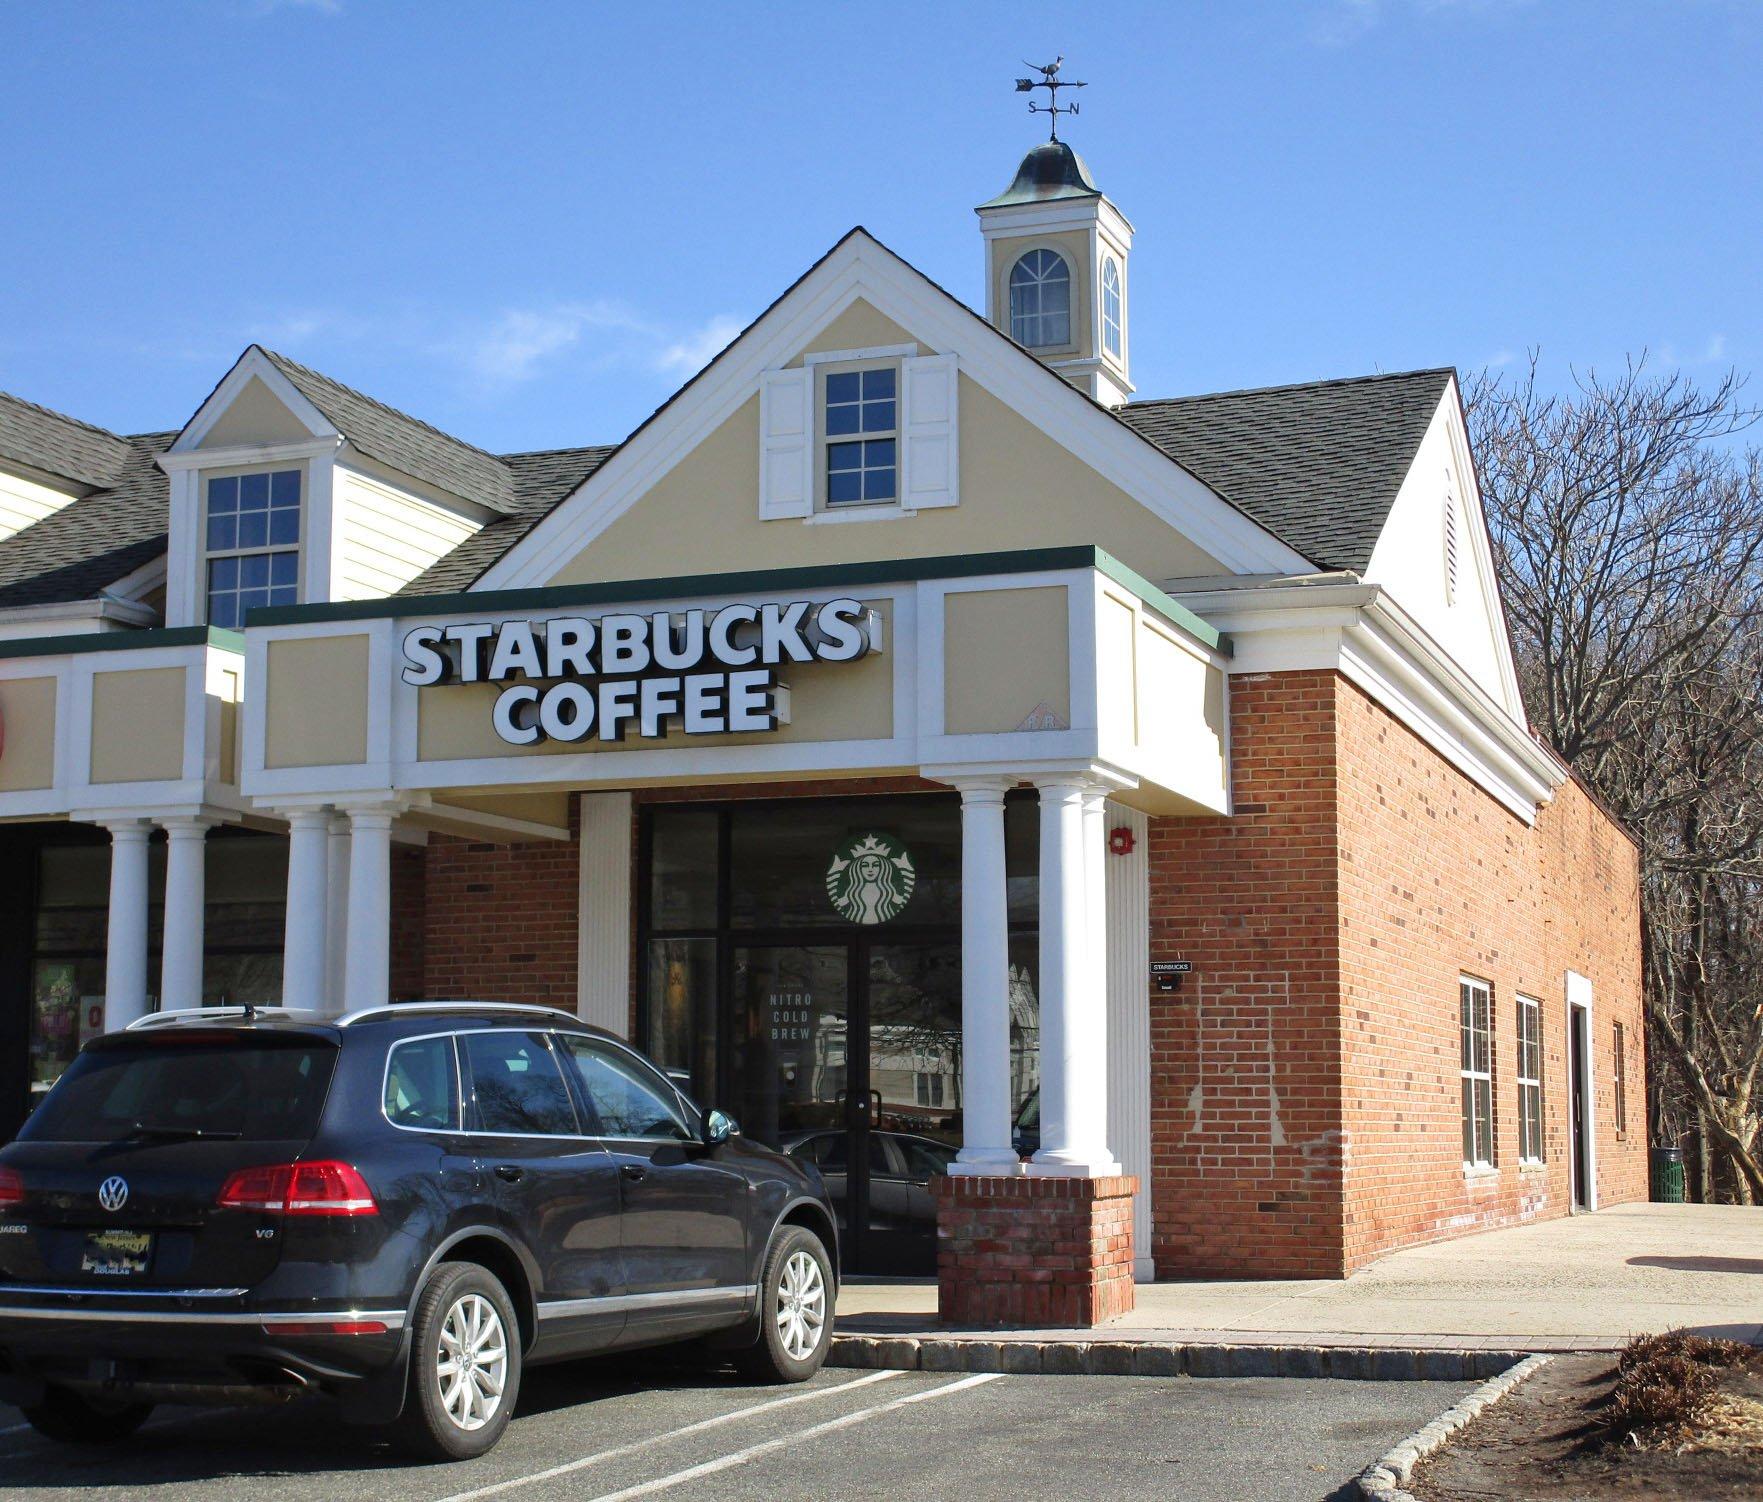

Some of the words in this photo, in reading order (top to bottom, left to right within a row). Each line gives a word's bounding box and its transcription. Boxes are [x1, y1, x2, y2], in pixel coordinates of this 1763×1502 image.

[1028, 101, 1036, 113] S
[1069, 102, 1079, 114] N
[401, 598, 867, 687] STARBUCKS
[491, 669, 779, 745] COFFEE
[769, 993, 811, 1006] NITRO
[773, 1011, 808, 1023] COLD
[771, 1028, 810, 1040] BREW
[255, 1229, 274, 1239] V6
